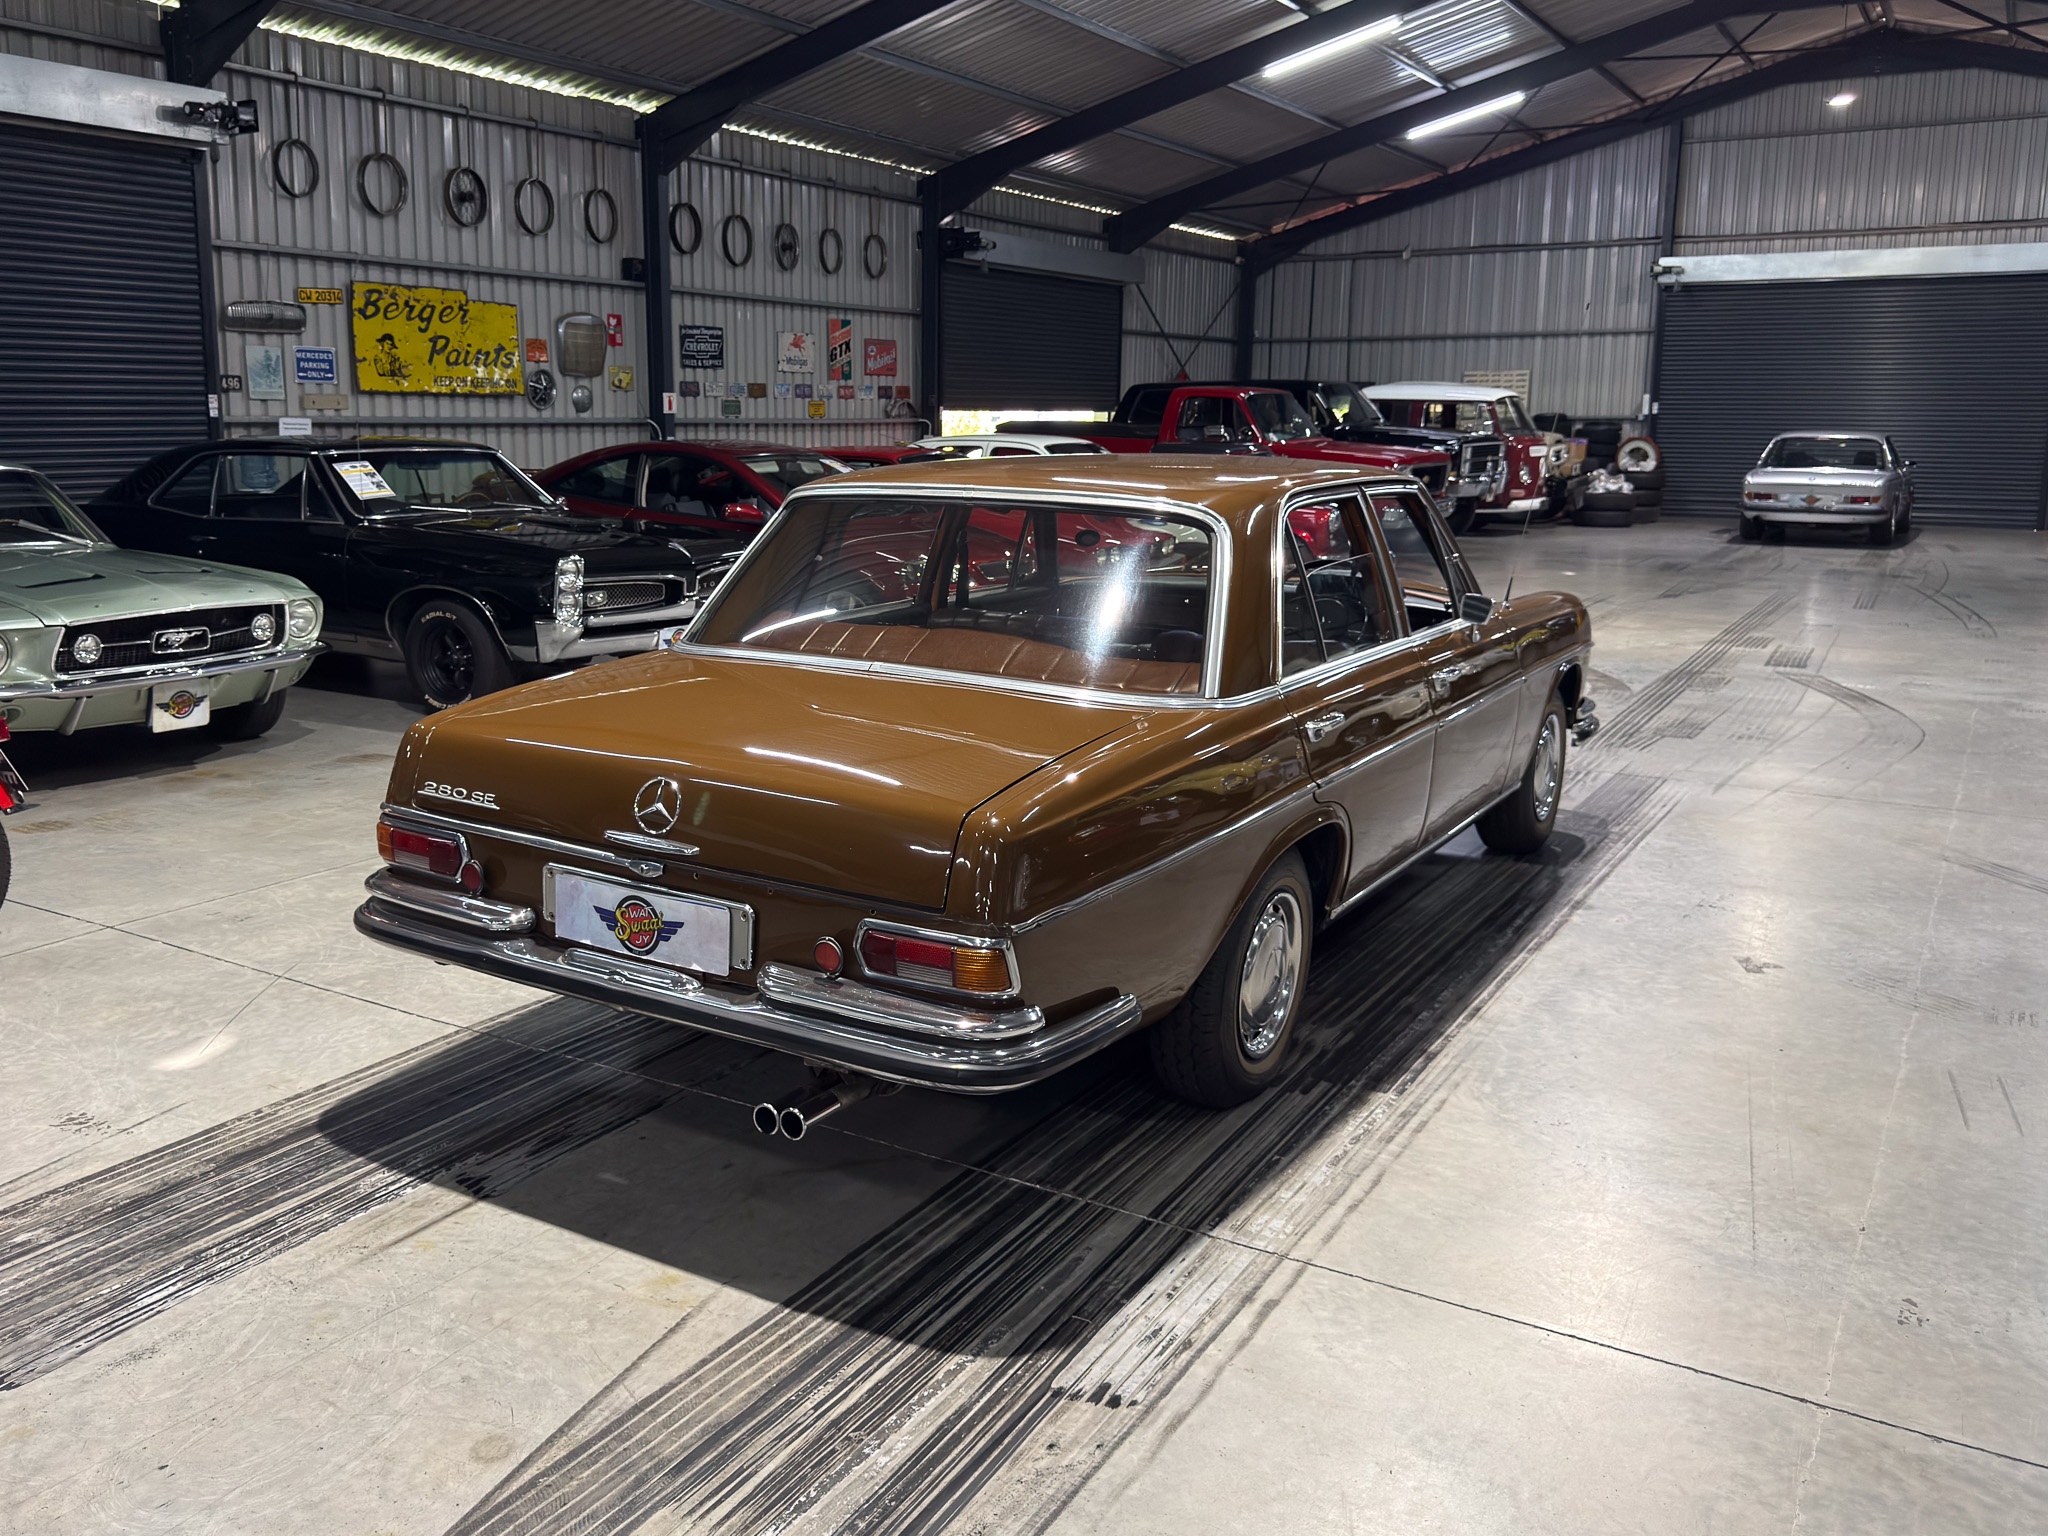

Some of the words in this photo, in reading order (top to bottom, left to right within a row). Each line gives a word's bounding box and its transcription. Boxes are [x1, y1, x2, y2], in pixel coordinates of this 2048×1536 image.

[299, 290, 313, 301] CW
[357, 288, 470, 333] Berger
[296, 351, 333, 360] MERCEDES
[428, 335, 517, 369] Paints
[830, 338, 851, 363] GTX
[300, 361, 330, 369] PARKING
[307, 371, 325, 379] ONLY
[433, 376, 454, 388] KEEP
[455, 376, 468, 388] ON
[505, 378, 518, 389] ON
[424, 781, 467, 799] 280
[471, 791, 496, 806] SE
[629, 906, 653, 918] WAT
[635, 935, 650, 944] JY
